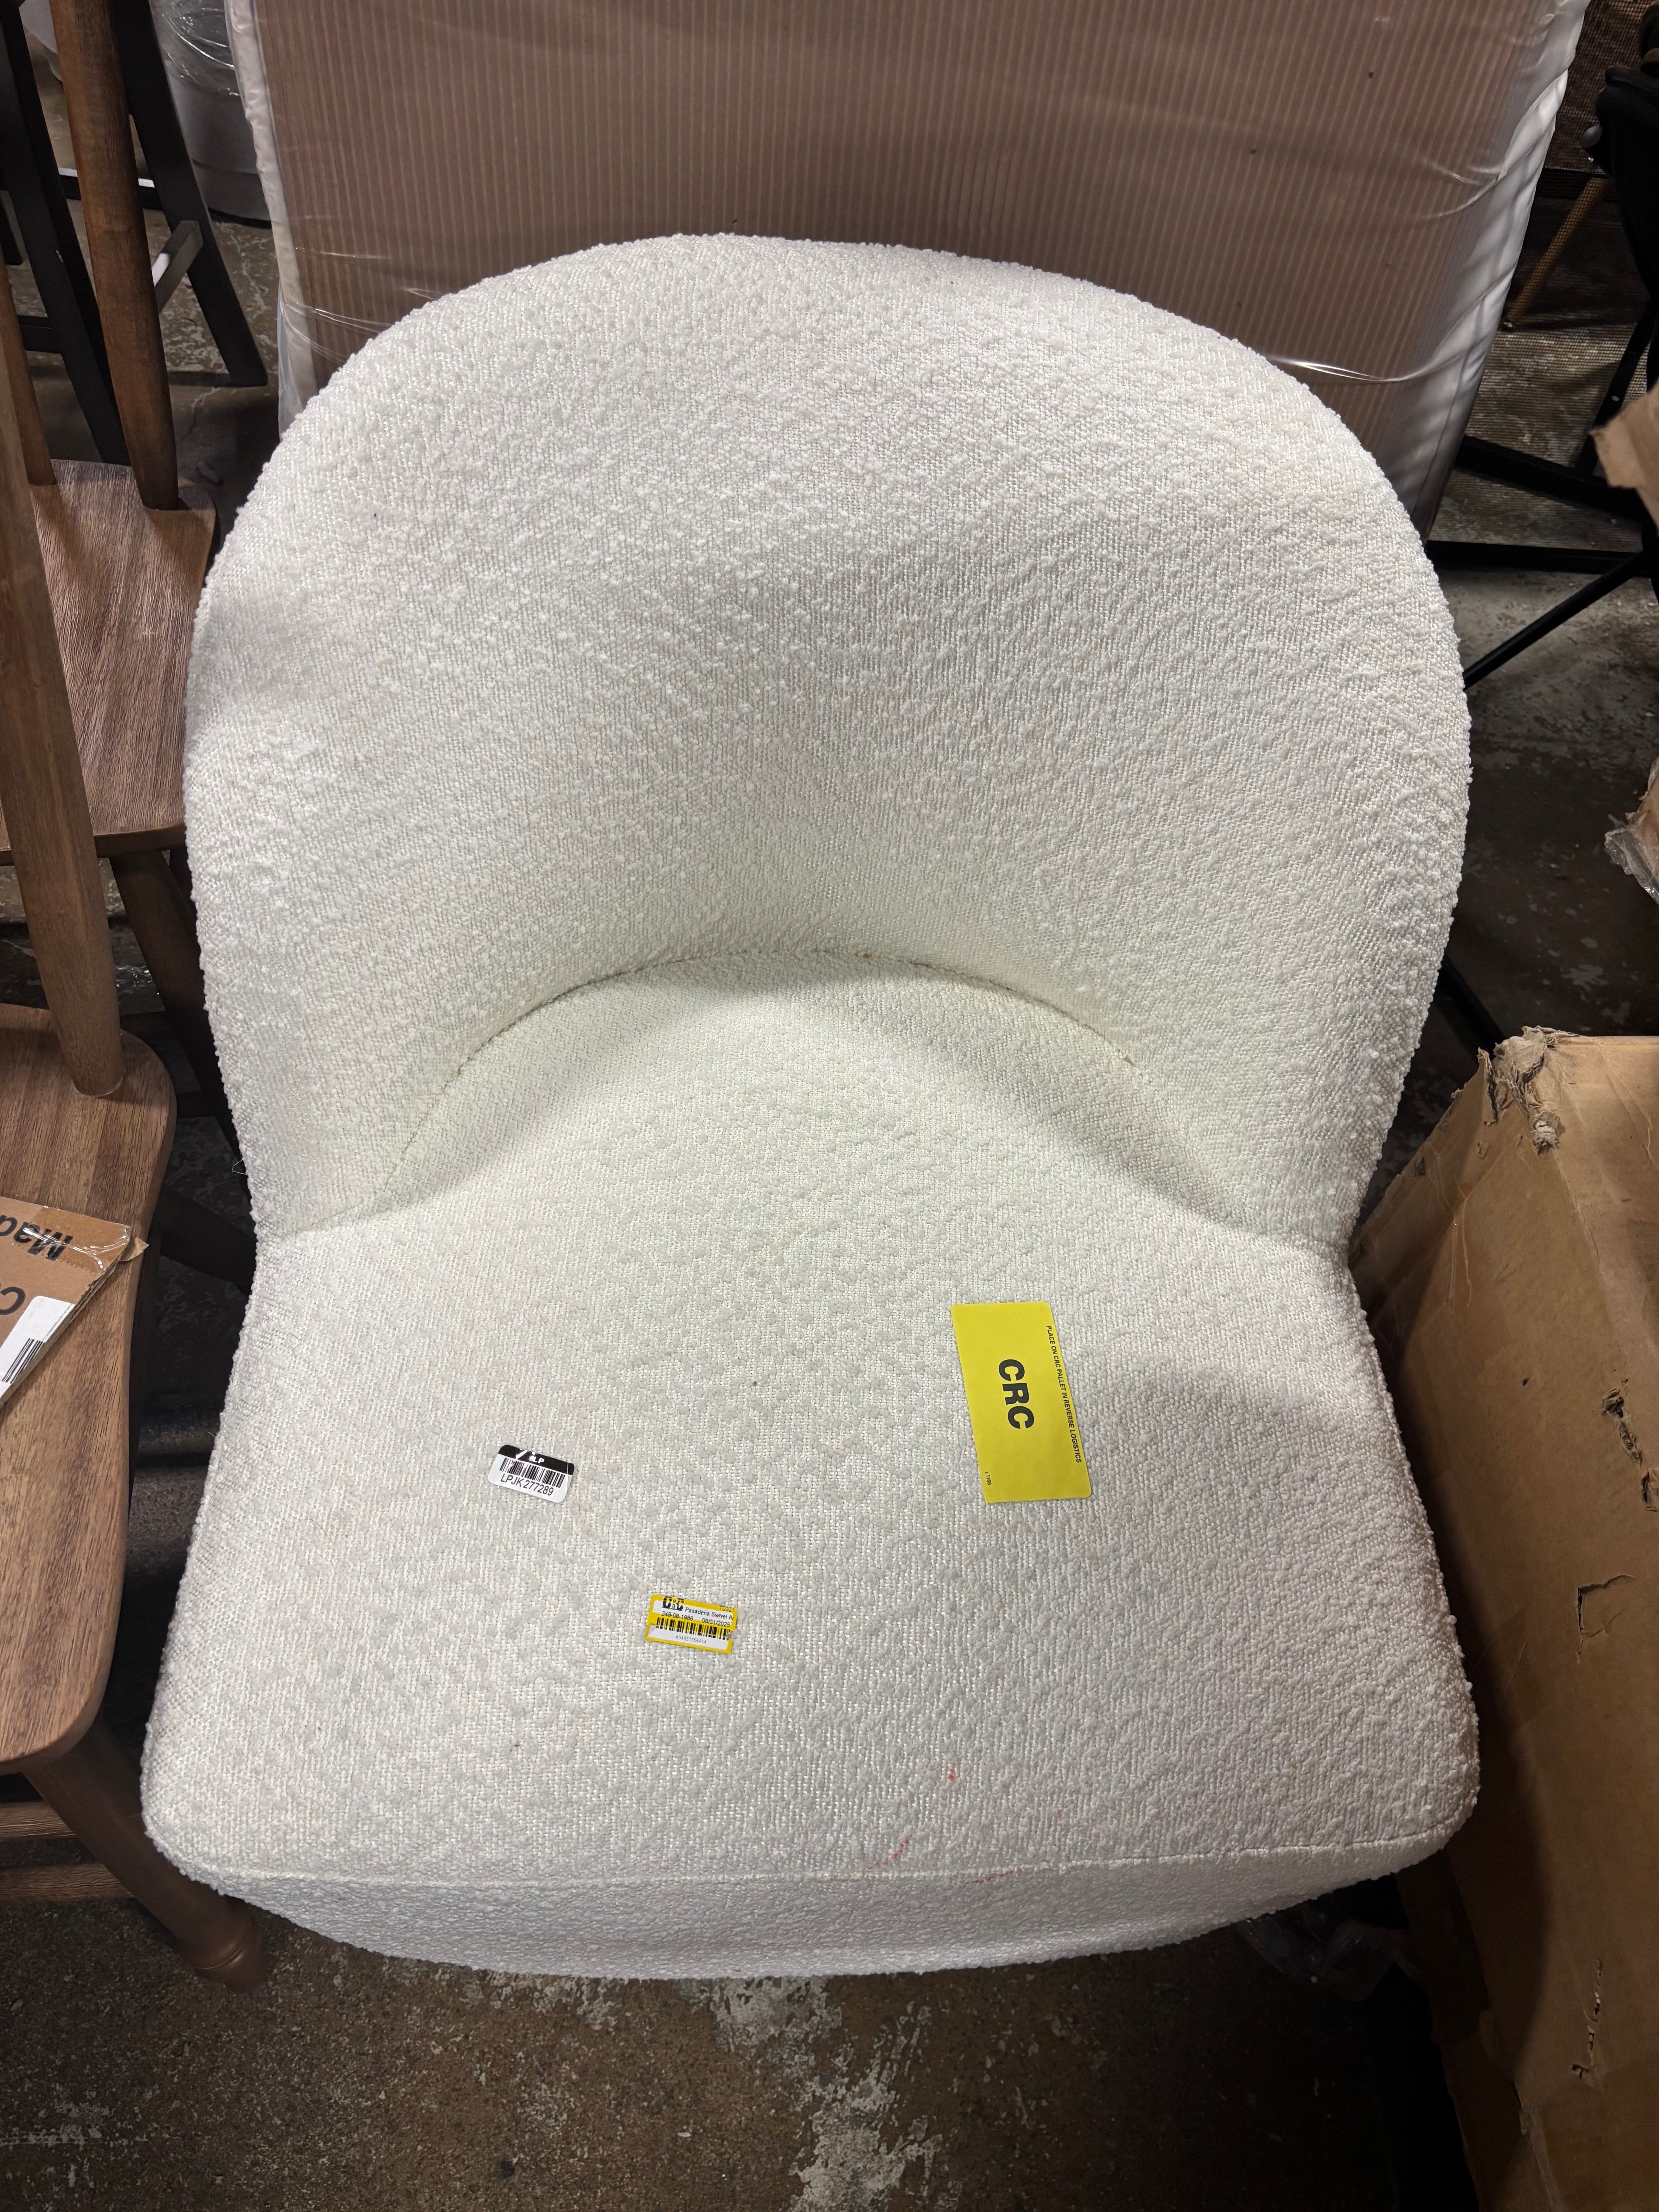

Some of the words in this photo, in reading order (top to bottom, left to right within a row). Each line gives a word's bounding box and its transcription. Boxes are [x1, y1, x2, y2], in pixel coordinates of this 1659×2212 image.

[0, 1283, 26, 1315] C
[998, 1359, 1034, 1429] CRC
[1046, 1325, 1055, 1345] PLACE
[1051, 1346, 1058, 1355] ON
[1057, 1369, 1066, 1391] PALLET
[1064, 1400, 1074, 1429] REVERSE
[1070, 1430, 1082, 1463] LOGISTICS
[501, 1474, 553, 1496] LPJK277289
[685, 1607, 709, 1616] Pasadena
[702, 1618, 730, 1627] 08/31/2025
